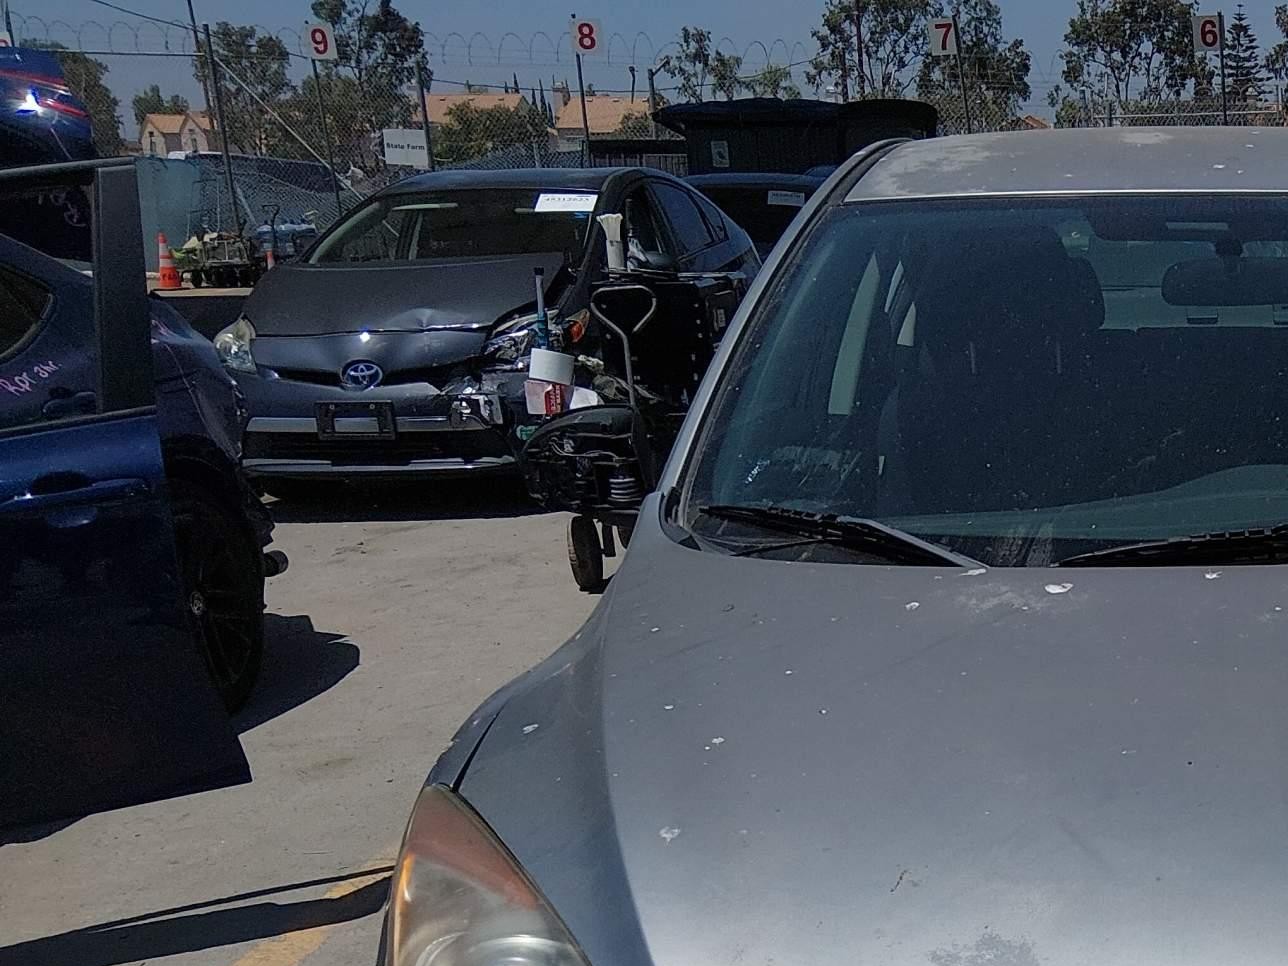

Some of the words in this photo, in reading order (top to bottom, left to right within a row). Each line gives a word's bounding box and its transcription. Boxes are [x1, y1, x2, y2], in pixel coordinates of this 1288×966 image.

[310, 27, 329, 55] 9
[577, 22, 596, 50] 8
[934, 22, 953, 51] 7
[1200, 19, 1219, 48] 6
[386, 142, 405, 150] State
[406, 143, 425, 151] Farm
